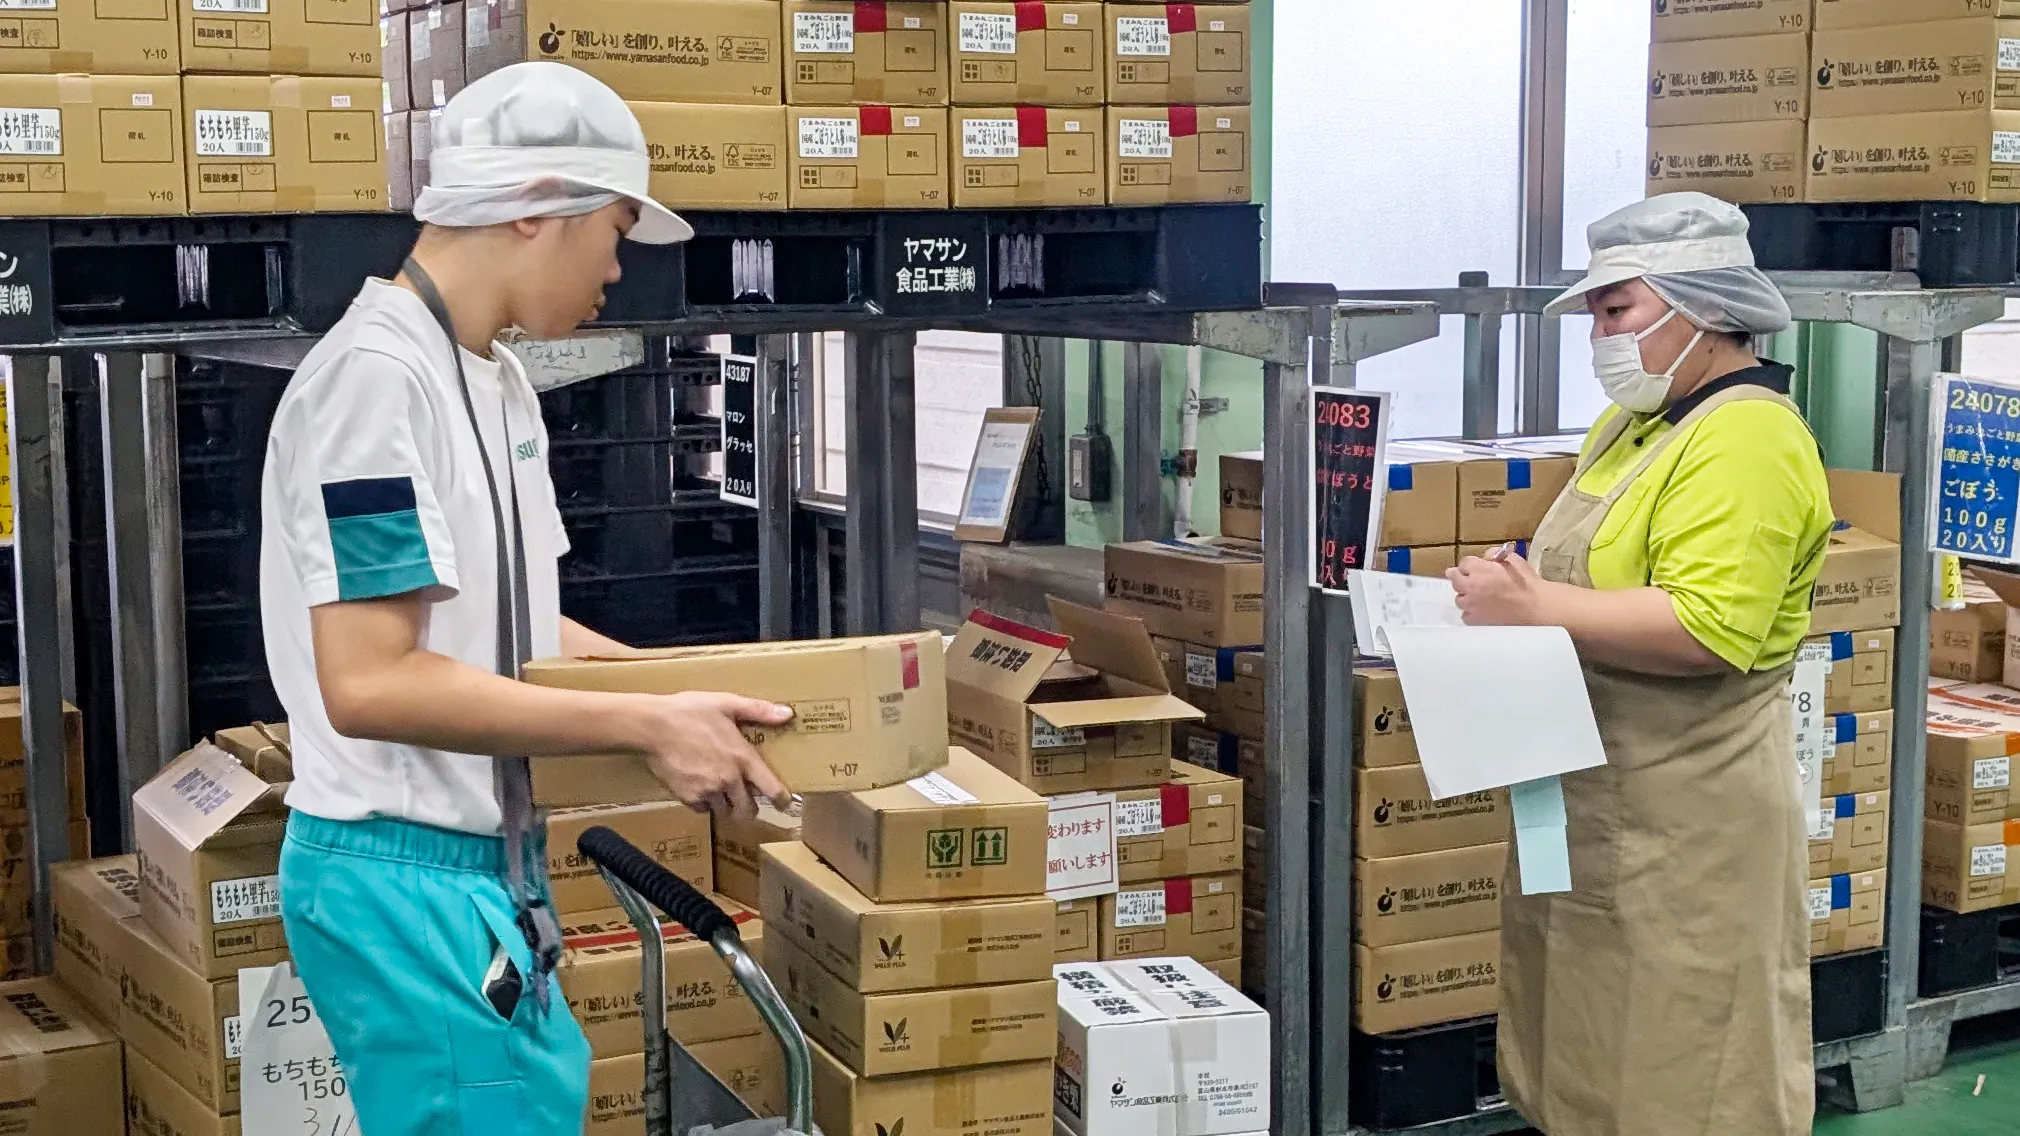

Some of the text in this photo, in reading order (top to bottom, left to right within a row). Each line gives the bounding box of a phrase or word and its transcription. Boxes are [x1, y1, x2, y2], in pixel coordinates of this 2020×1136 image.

[1779, 15, 1803, 28] Y-10
[143, 49, 168, 60] Y-10
[349, 53, 372, 63] Y-10
[752, 86, 773, 96] Y-07
[1958, 90, 1985, 104] Y-10
[1775, 100, 1798, 113] Y-10
[354, 189, 377, 200] Y-10
[1771, 185, 1795, 198] Y-10
[1949, 181, 1976, 195] Y-10
[149, 190, 174, 201] Y-10
[759, 192, 779, 201] Y-07
[920, 191, 939, 200] Y-07
[904, 237, 968, 263] ヤマサン
[726, 364, 751, 383] 43187
[1950, 388, 2020, 418] 24078
[726, 410, 746, 424] マロン
[726, 436, 753, 454] グラッセ
[1944, 479, 1999, 502] ごぼう
[828, 763, 858, 777] Y-07
[1934, 801, 1960, 817] Y-10
